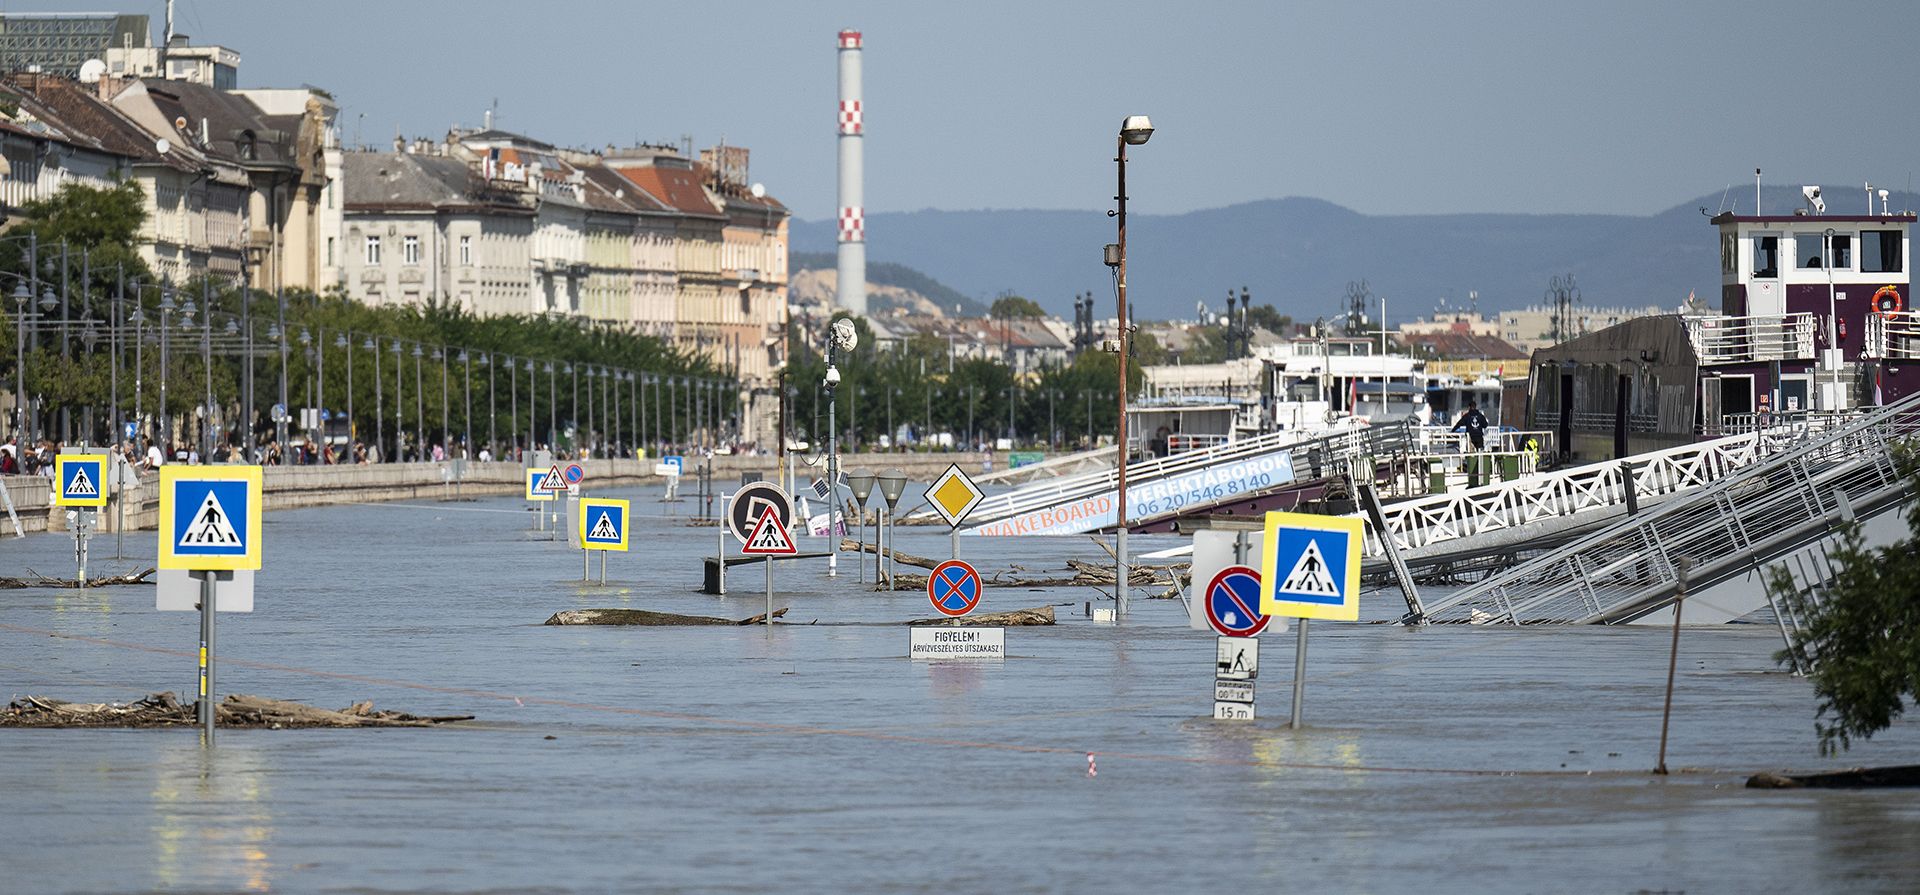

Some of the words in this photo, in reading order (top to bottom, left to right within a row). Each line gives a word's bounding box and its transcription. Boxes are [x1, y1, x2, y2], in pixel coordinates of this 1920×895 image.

[1137, 500, 1159, 516] 06
[1163, 484, 1224, 511] 20/546
[1227, 473, 1271, 495] 8140
[980, 497, 1111, 535] WAKEBOARD
[912, 642, 963, 653] ÁRVÍZVESZÉLYES
[964, 642, 999, 653] ÚTSZAKASZ
[1236, 710, 1248, 719] m
